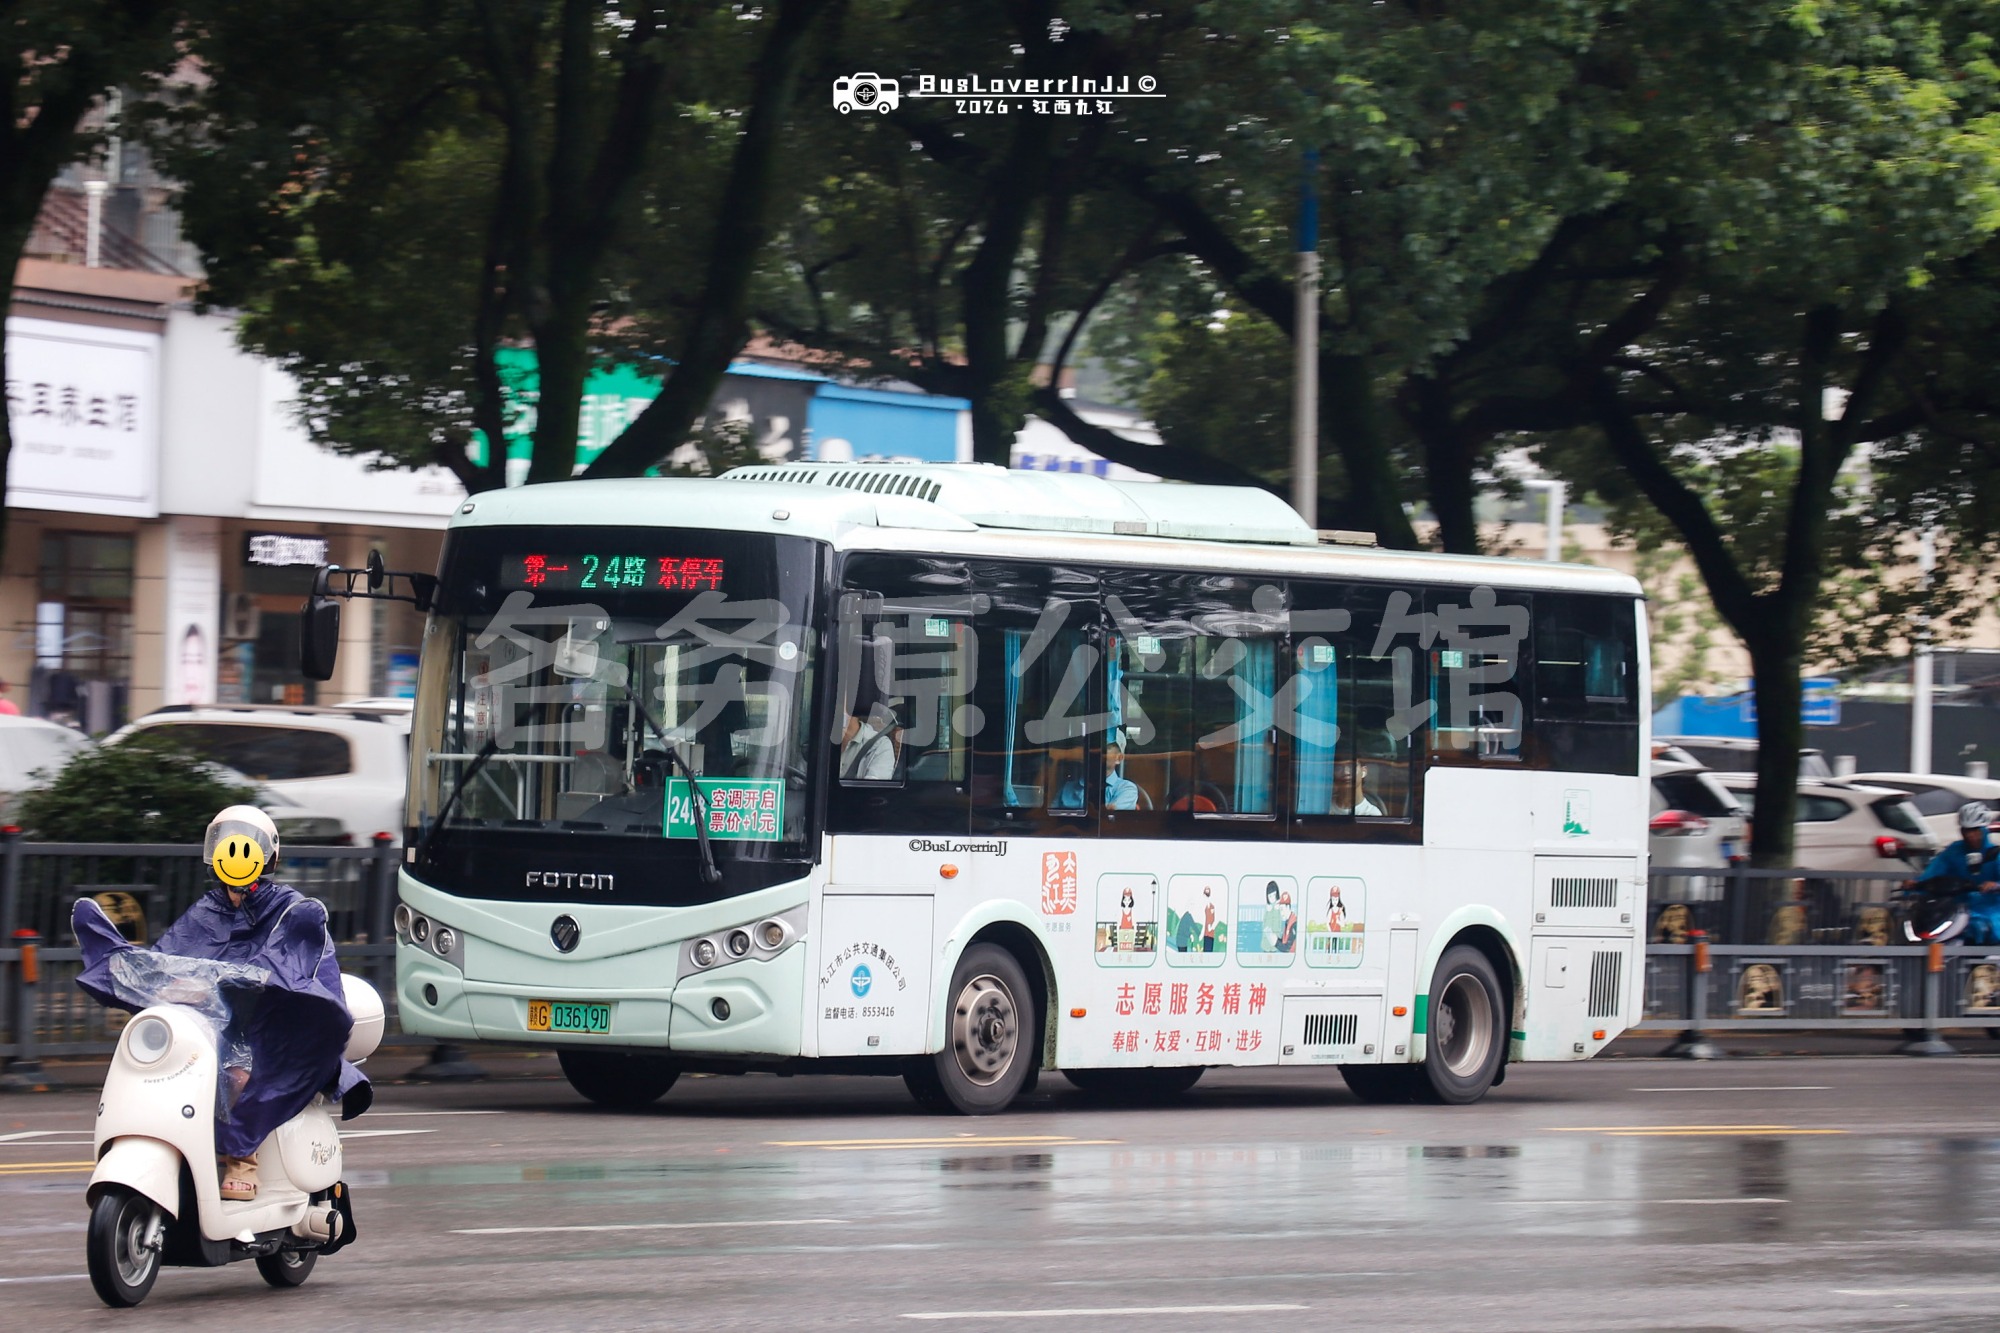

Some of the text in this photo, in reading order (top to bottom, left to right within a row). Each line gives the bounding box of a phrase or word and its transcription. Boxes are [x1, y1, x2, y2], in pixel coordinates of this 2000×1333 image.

[581, 554, 647, 589] 24路
[710, 788, 776, 810] 空调开启
[708, 811, 776, 833] 票价+1元
[526, 871, 614, 890] FOTON
[820, 942, 907, 991] 九江市公共交通集团公司
[1115, 982, 1267, 1016] 志愿服务精神
